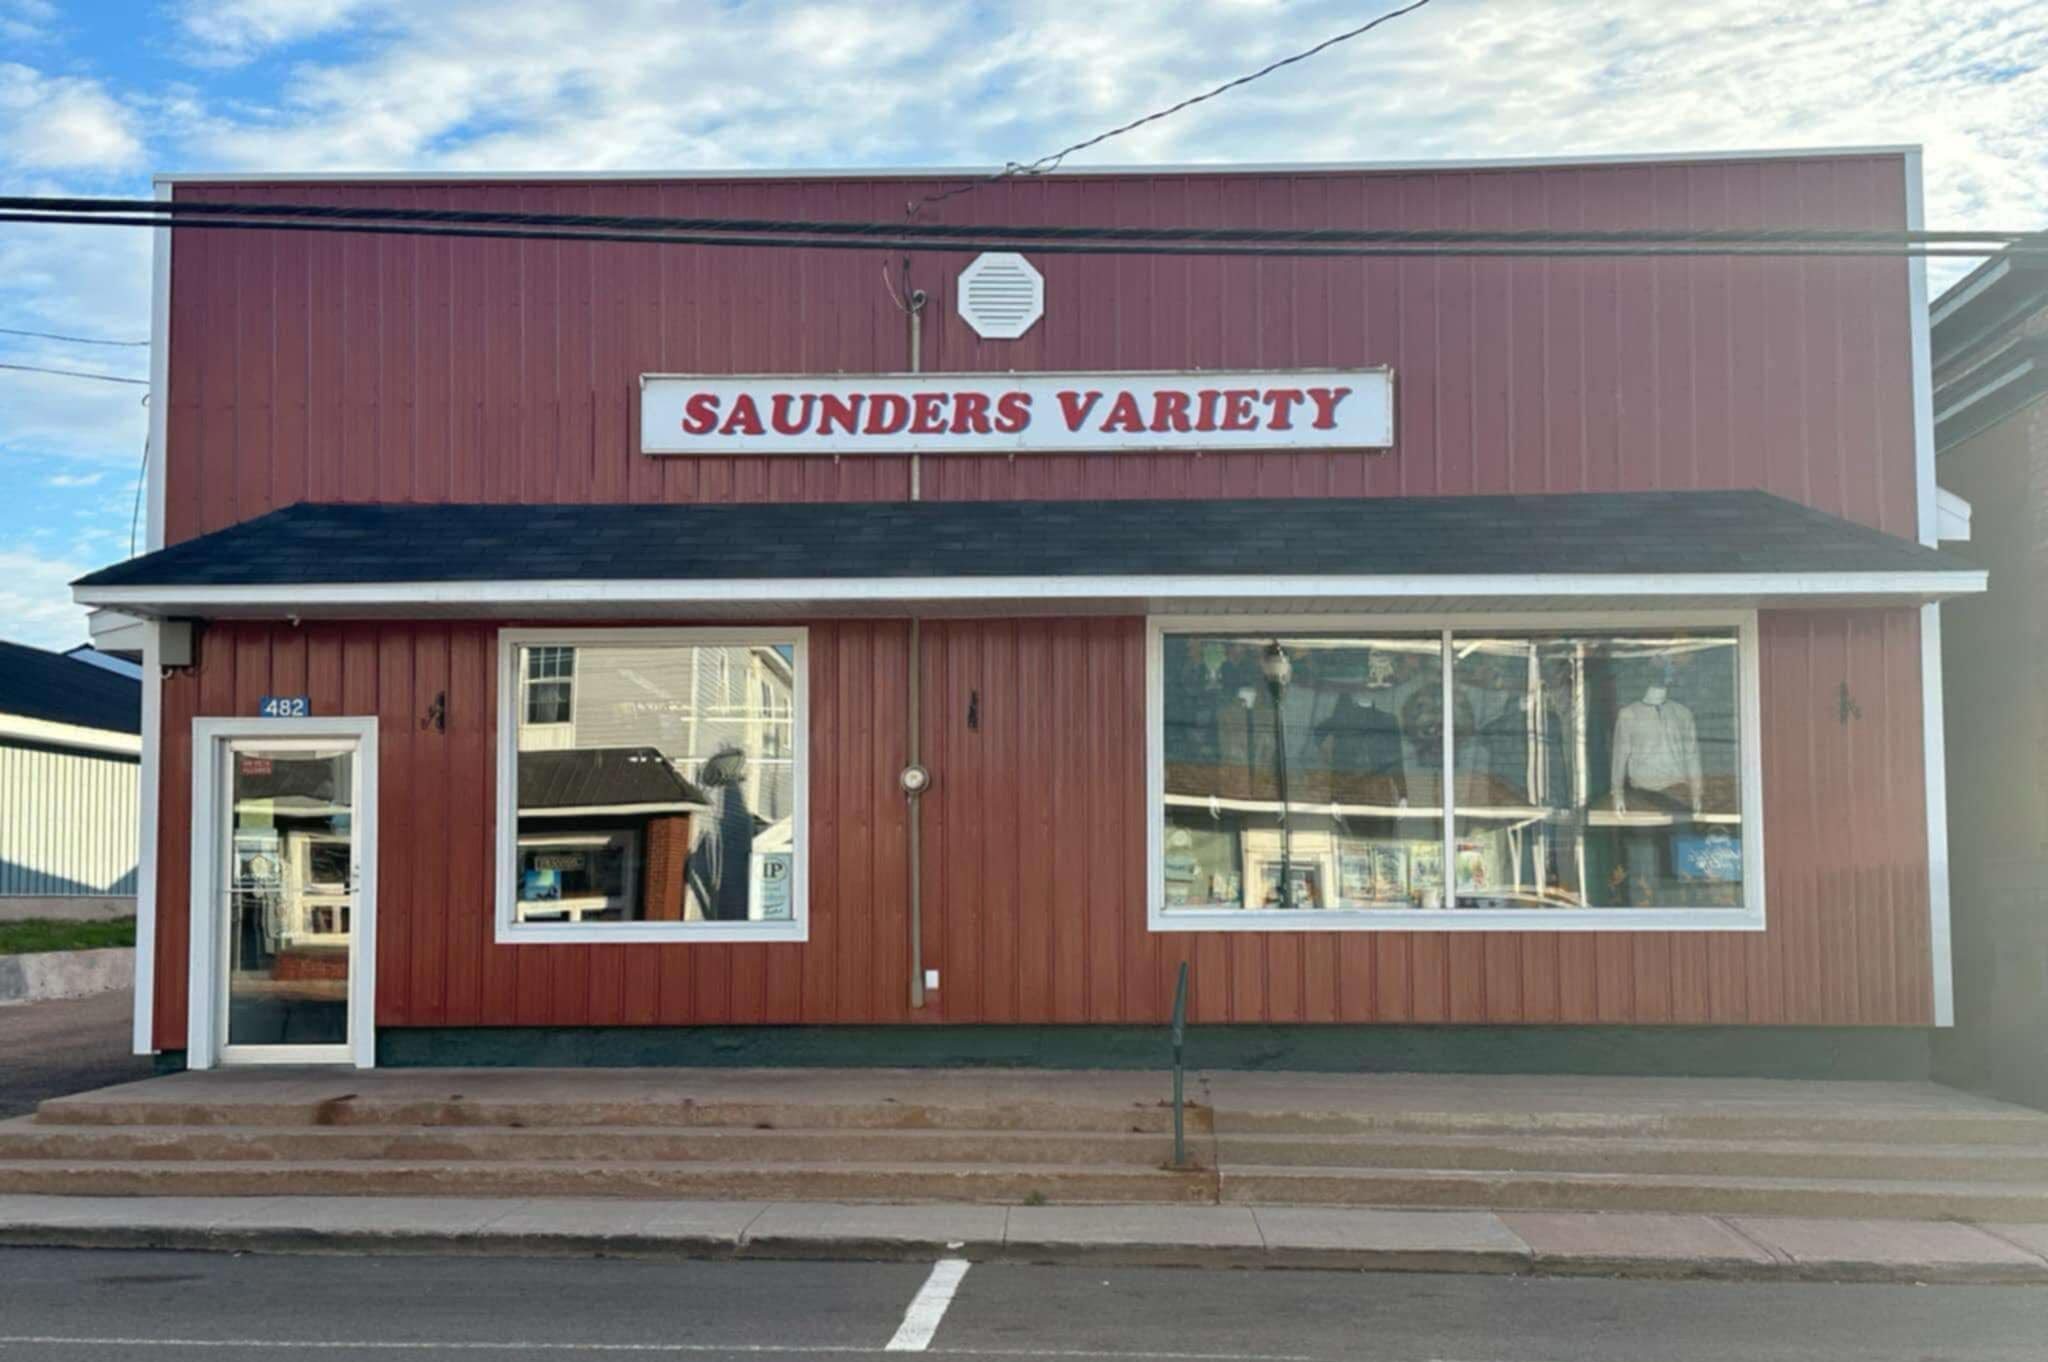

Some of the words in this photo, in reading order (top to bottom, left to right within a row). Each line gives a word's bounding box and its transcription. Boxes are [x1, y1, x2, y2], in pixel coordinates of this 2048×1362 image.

[682, 392, 1031, 436] SAUNDERS
[1055, 387, 1352, 432] VARIETY
[264, 698, 304, 716] 482
